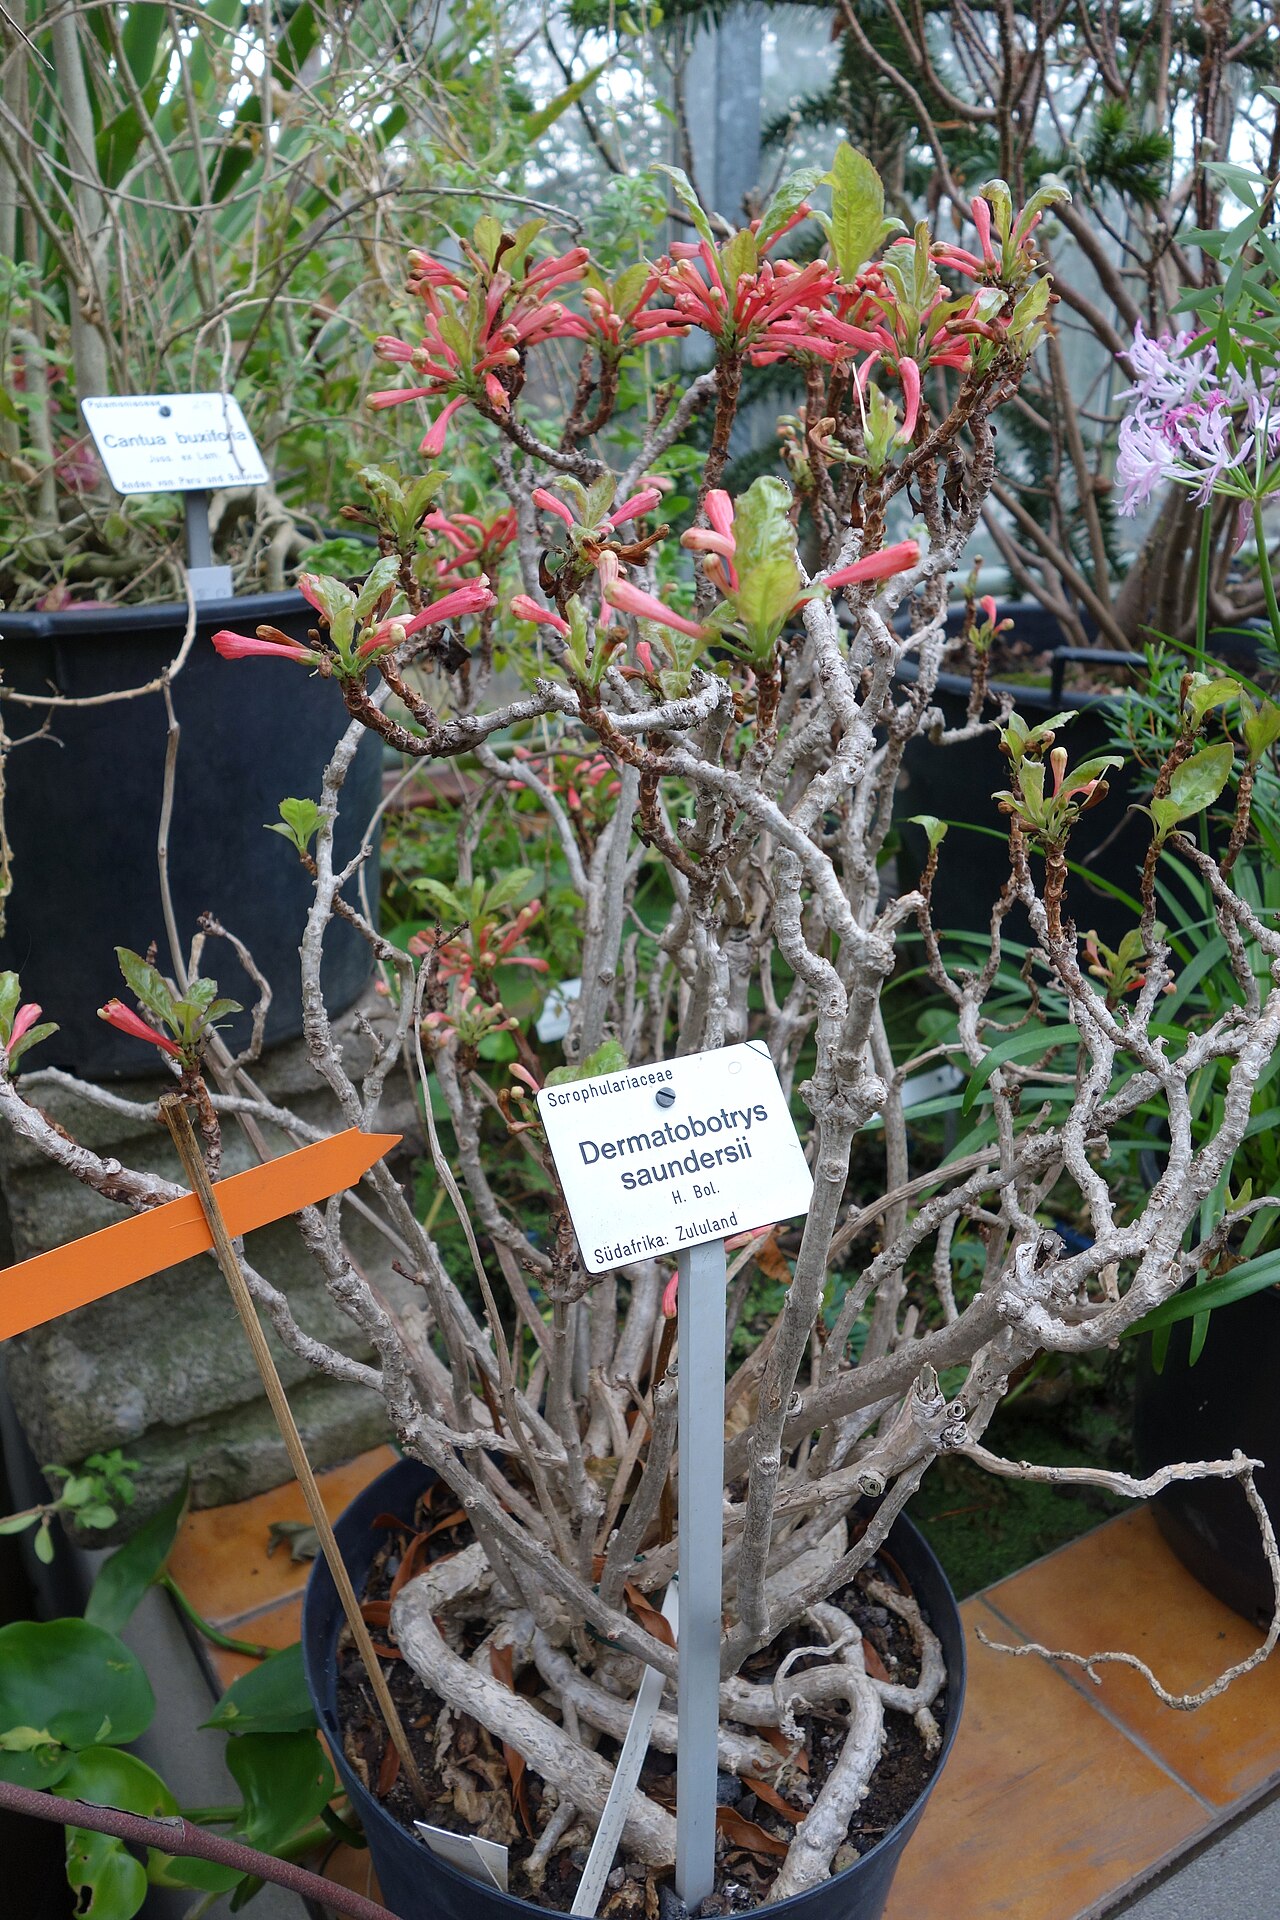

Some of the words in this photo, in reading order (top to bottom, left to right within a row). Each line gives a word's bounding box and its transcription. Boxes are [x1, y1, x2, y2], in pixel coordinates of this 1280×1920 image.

[103, 433, 167, 449] Cantua
[175, 429, 247, 445] buxifoia
[158, 479, 174, 487] von
[206, 475, 224, 483] und
[547, 1068, 674, 1107] Scrophulariaceae
[578, 1104, 769, 1165] Dermatobotrys
[620, 1136, 752, 1190] saundersii
[672, 1189, 687, 1205] H.
[693, 1181, 720, 1199] Bol.
[594, 1233, 669, 1264] Südafrika:
[675, 1211, 738, 1241] Zululand
